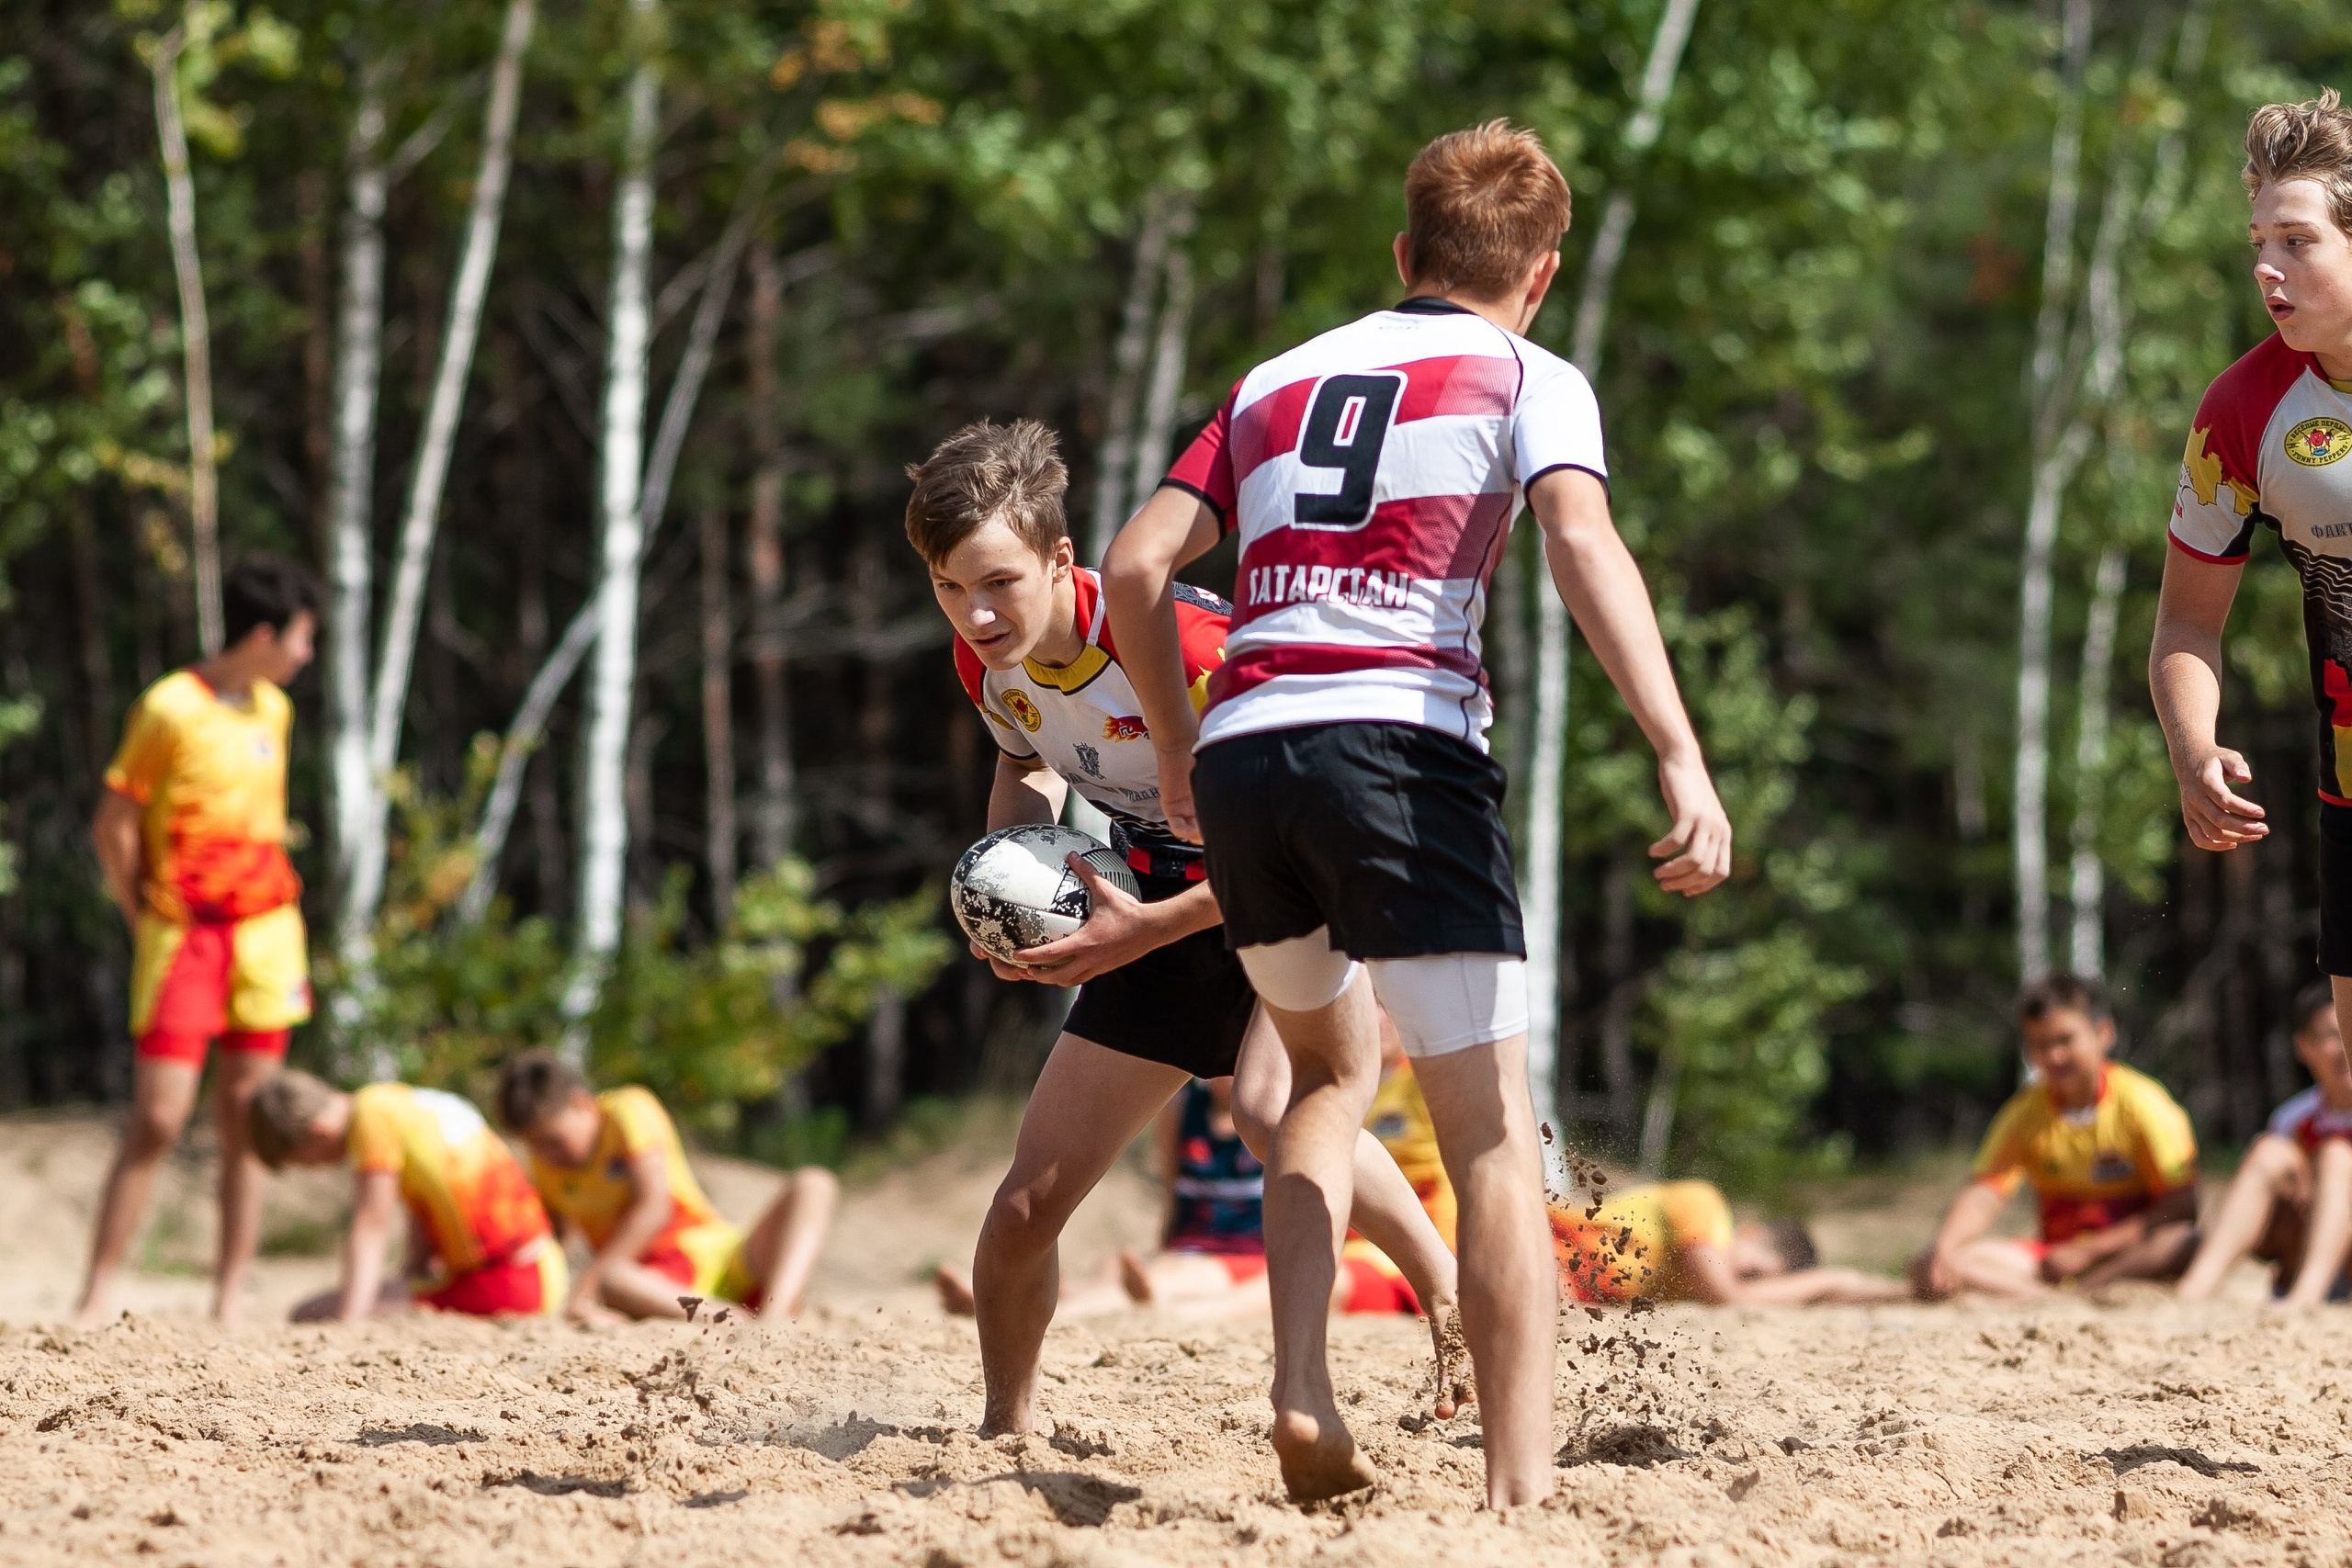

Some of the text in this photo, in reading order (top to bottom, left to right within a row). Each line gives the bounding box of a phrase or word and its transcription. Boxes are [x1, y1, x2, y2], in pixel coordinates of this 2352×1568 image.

[1291, 371, 1408, 529] 9
[2292, 445, 2348, 464] FUNNY PEPPERS
